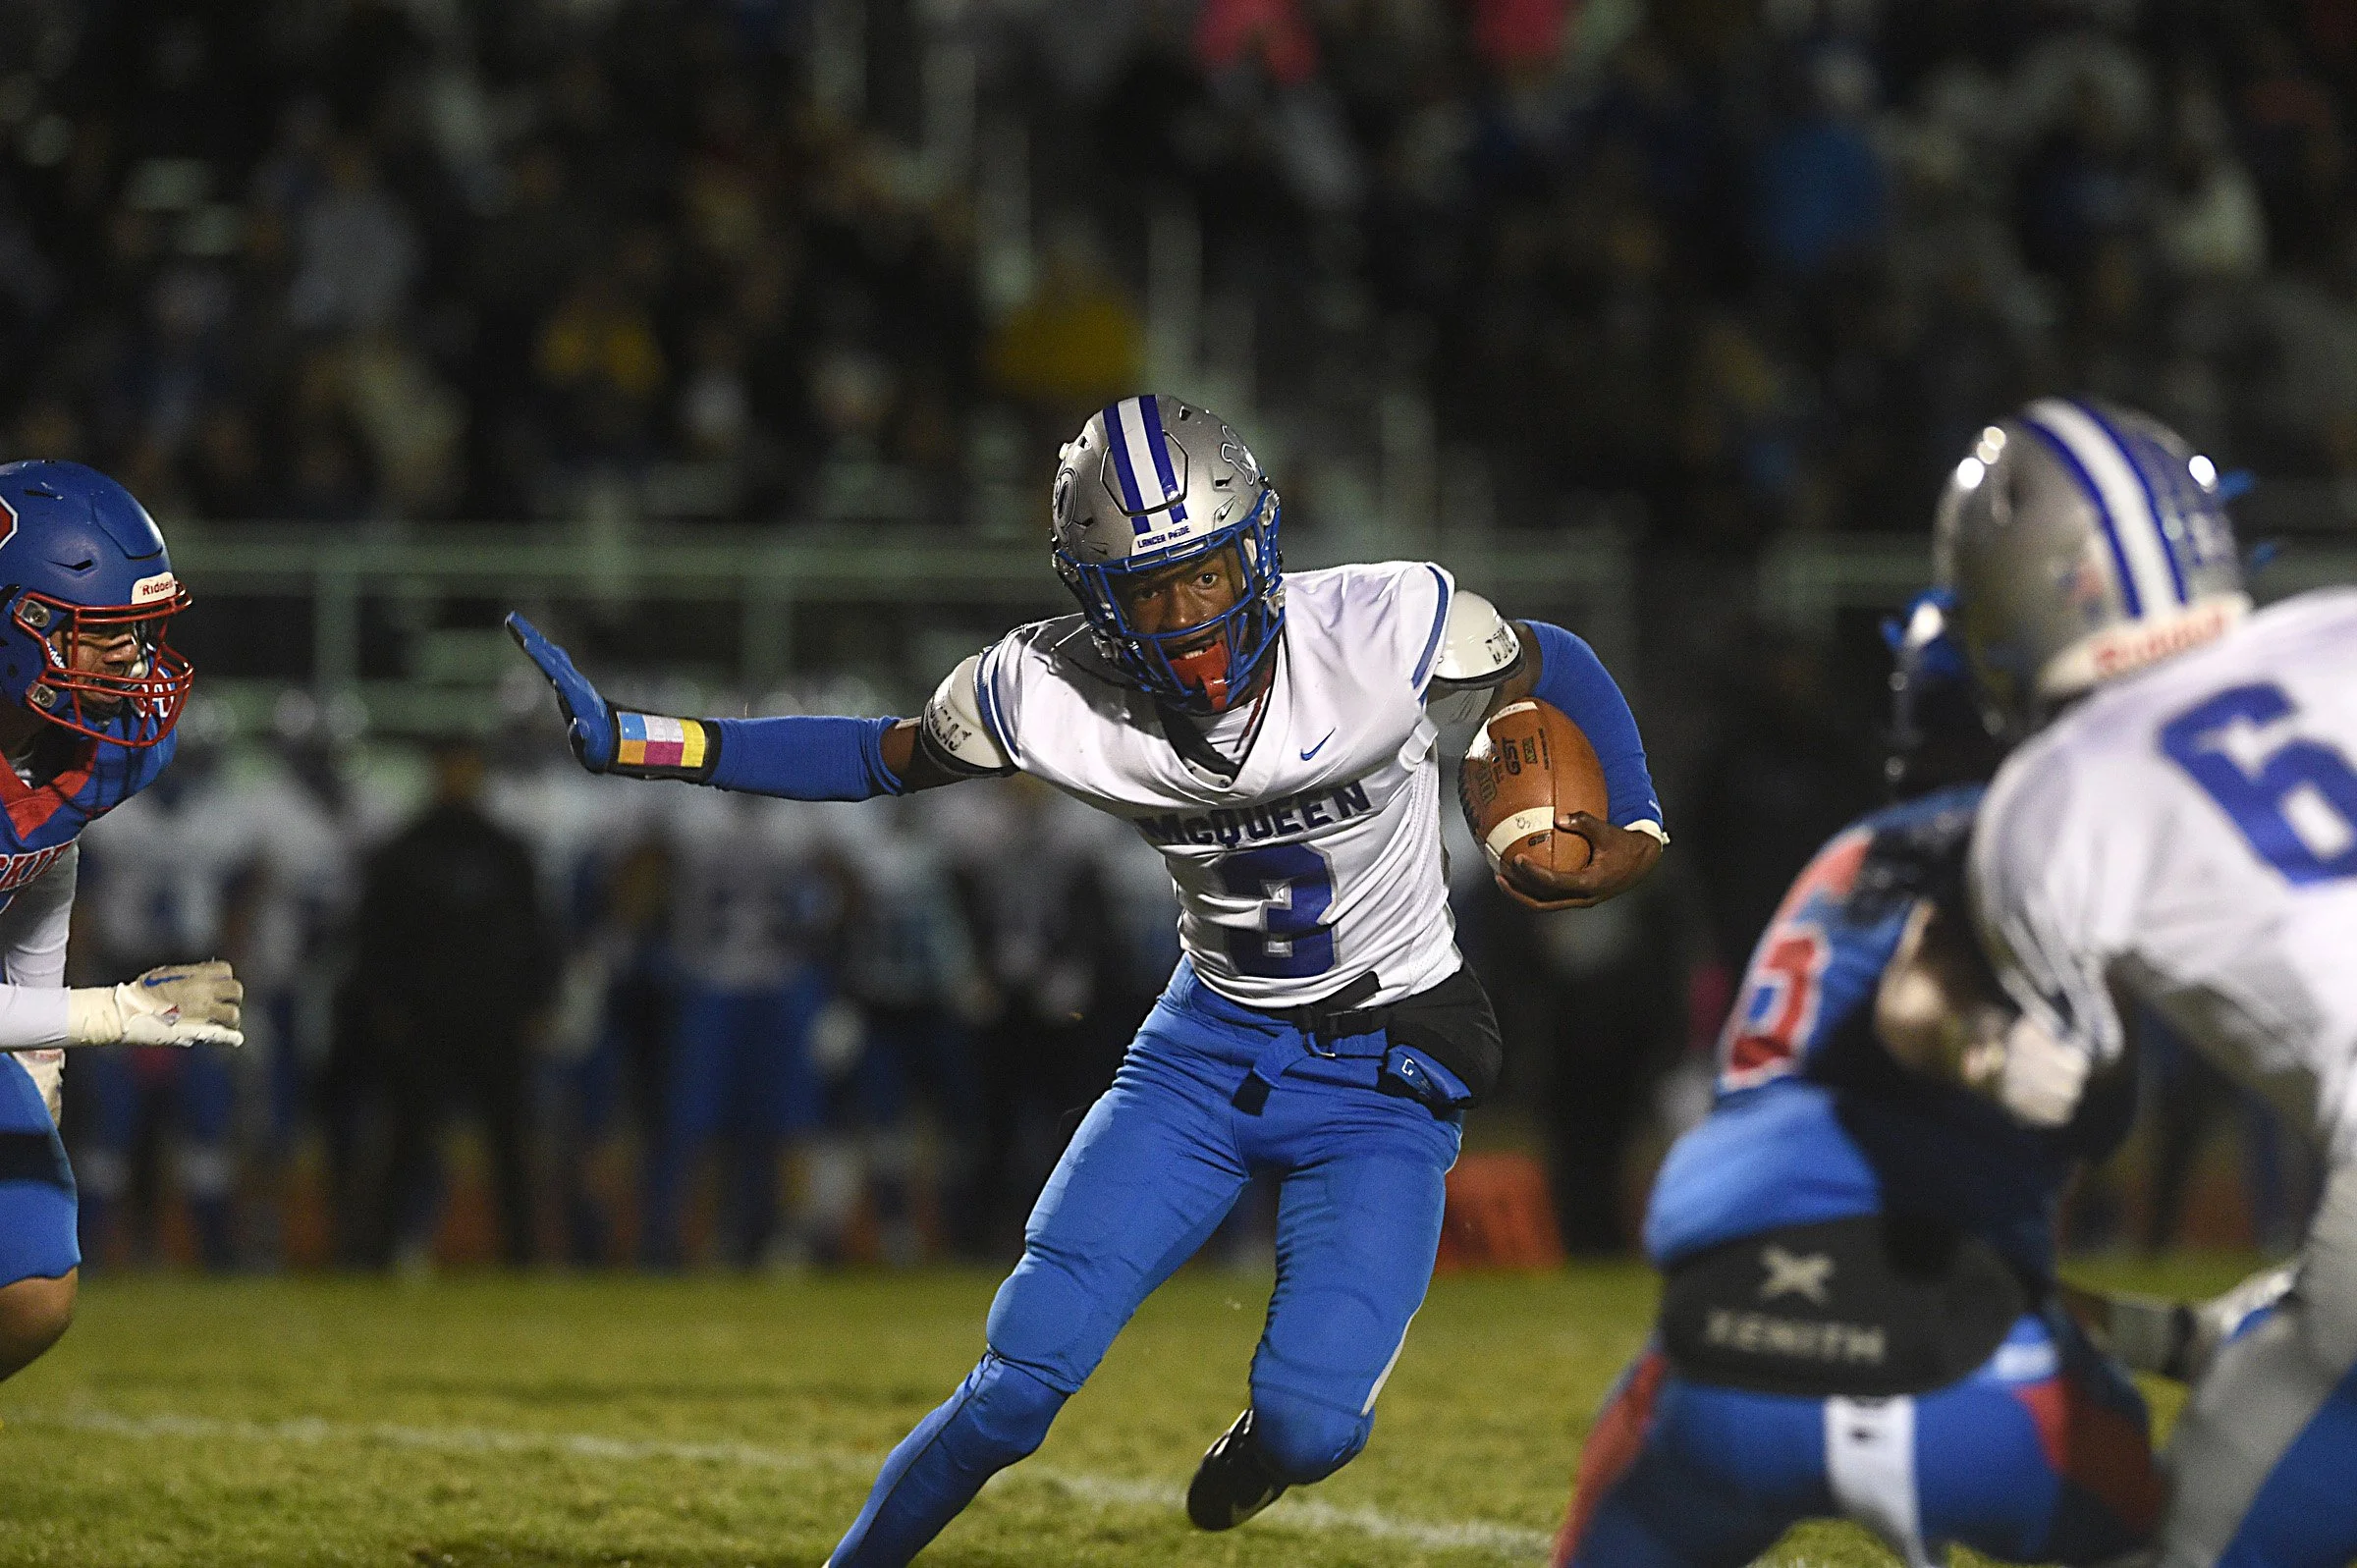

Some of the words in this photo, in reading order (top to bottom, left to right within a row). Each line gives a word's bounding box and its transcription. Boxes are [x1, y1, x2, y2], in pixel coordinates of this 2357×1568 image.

[1135, 779, 1371, 848] MCQUEEN
[2160, 682, 2357, 886] 6
[1223, 841, 1338, 977] 3
